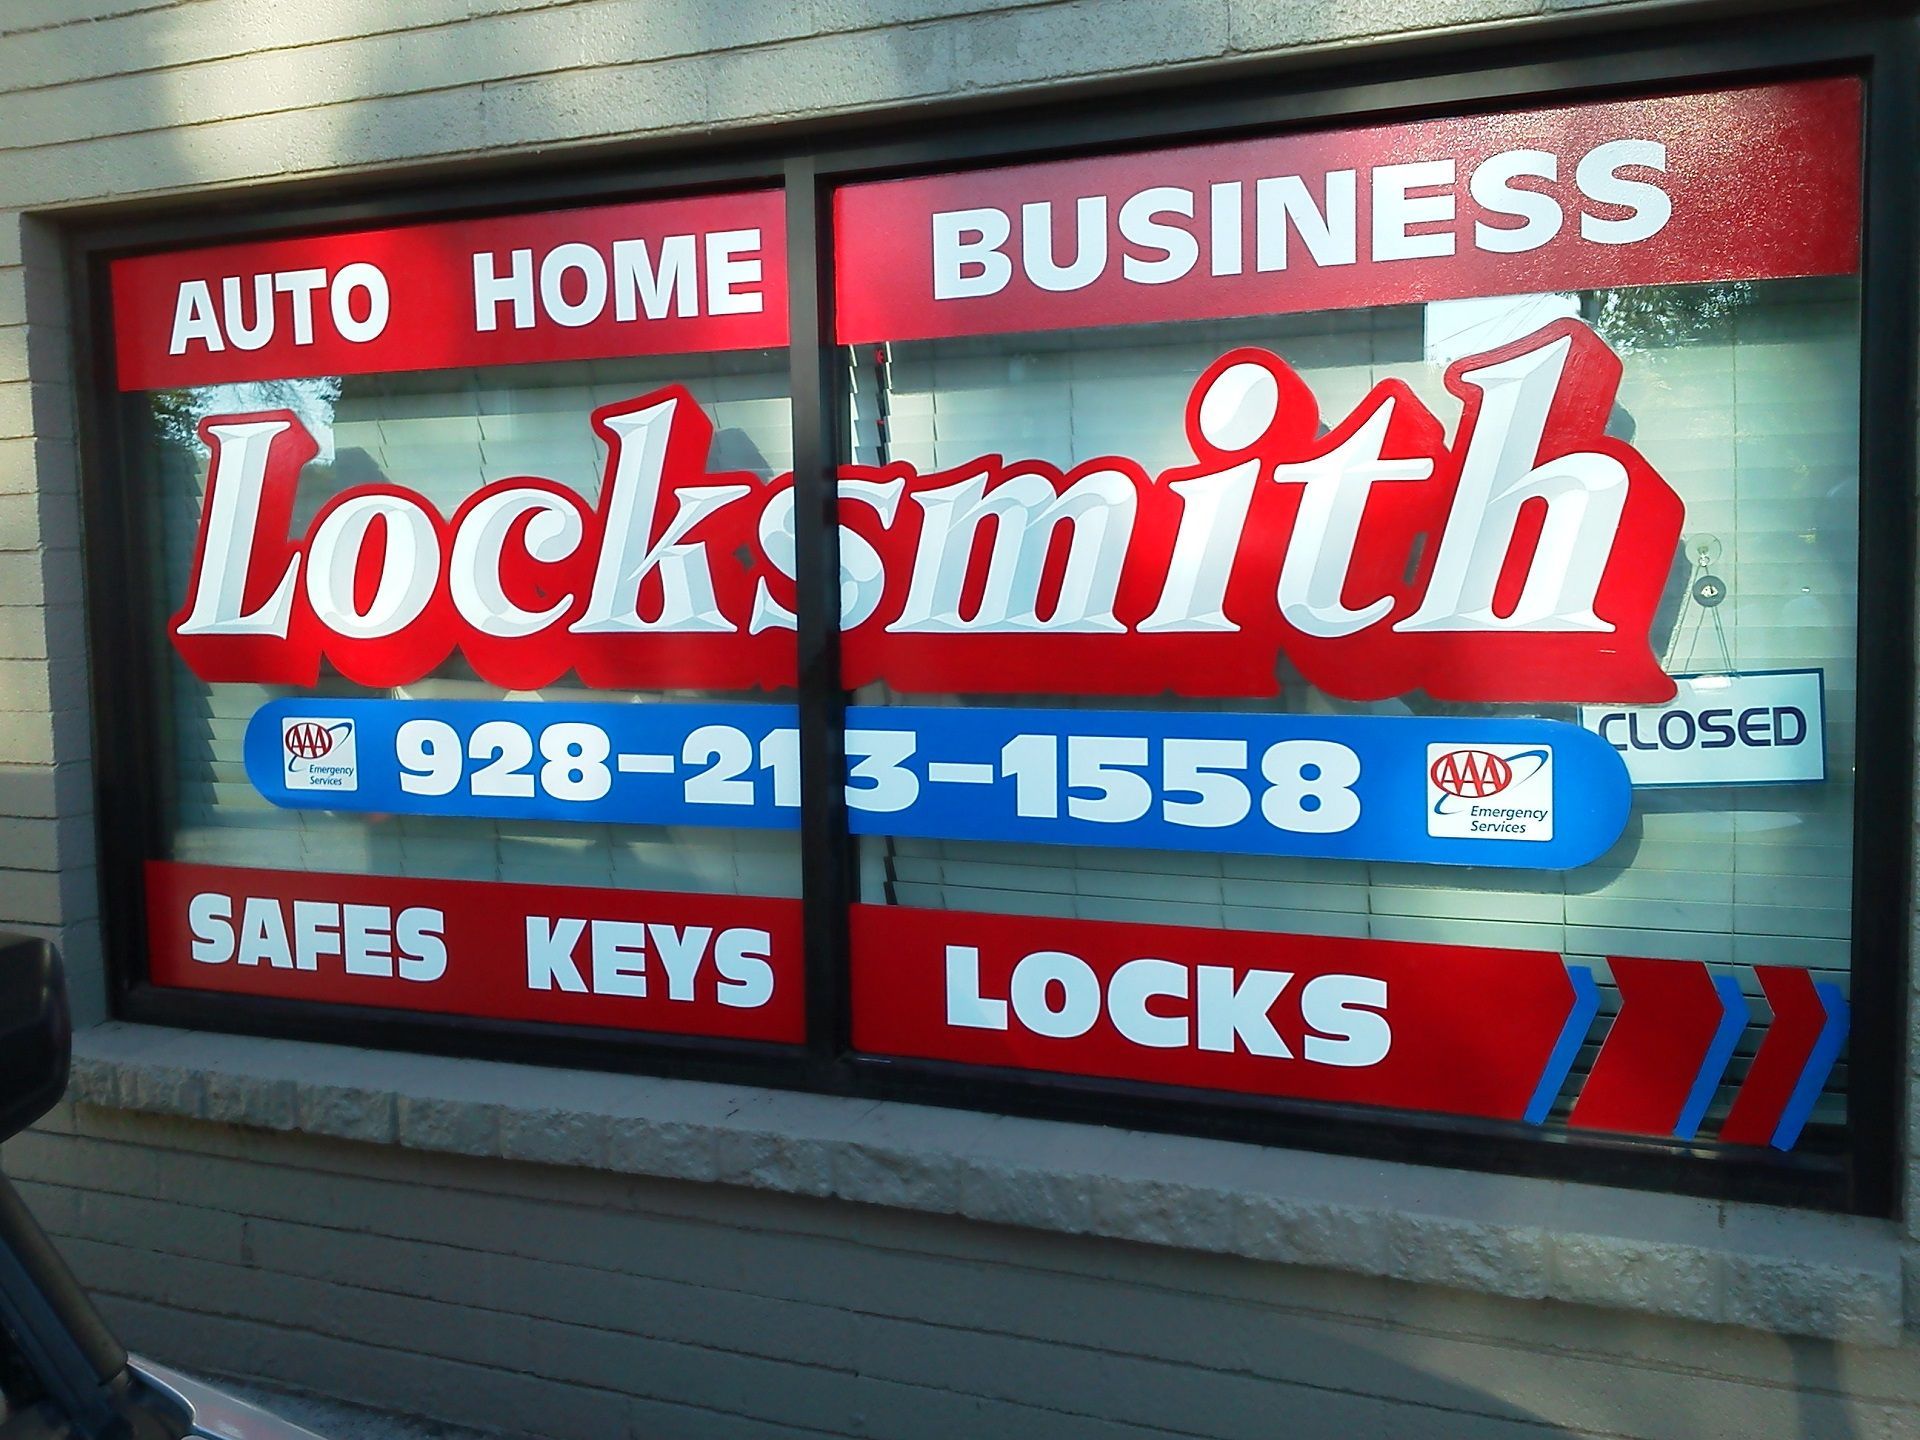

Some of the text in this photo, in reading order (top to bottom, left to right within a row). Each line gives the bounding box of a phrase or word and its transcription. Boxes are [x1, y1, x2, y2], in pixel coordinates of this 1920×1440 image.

[932, 140, 1673, 301] BUSINESS
[169, 229, 763, 356] AUTO HOME
[177, 333, 1617, 640] Locksmith
[289, 723, 329, 759] AAA
[1599, 706, 1807, 750] CLOSED
[309, 764, 354, 776] Emergency
[310, 776, 342, 785] Services
[1439, 750, 1503, 797] AAA
[1470, 805, 1548, 822] Emergency
[1470, 820, 1526, 833] Services
[188, 893, 775, 1008] SAFES KEYS
[945, 945, 1391, 1066] LOCKS
